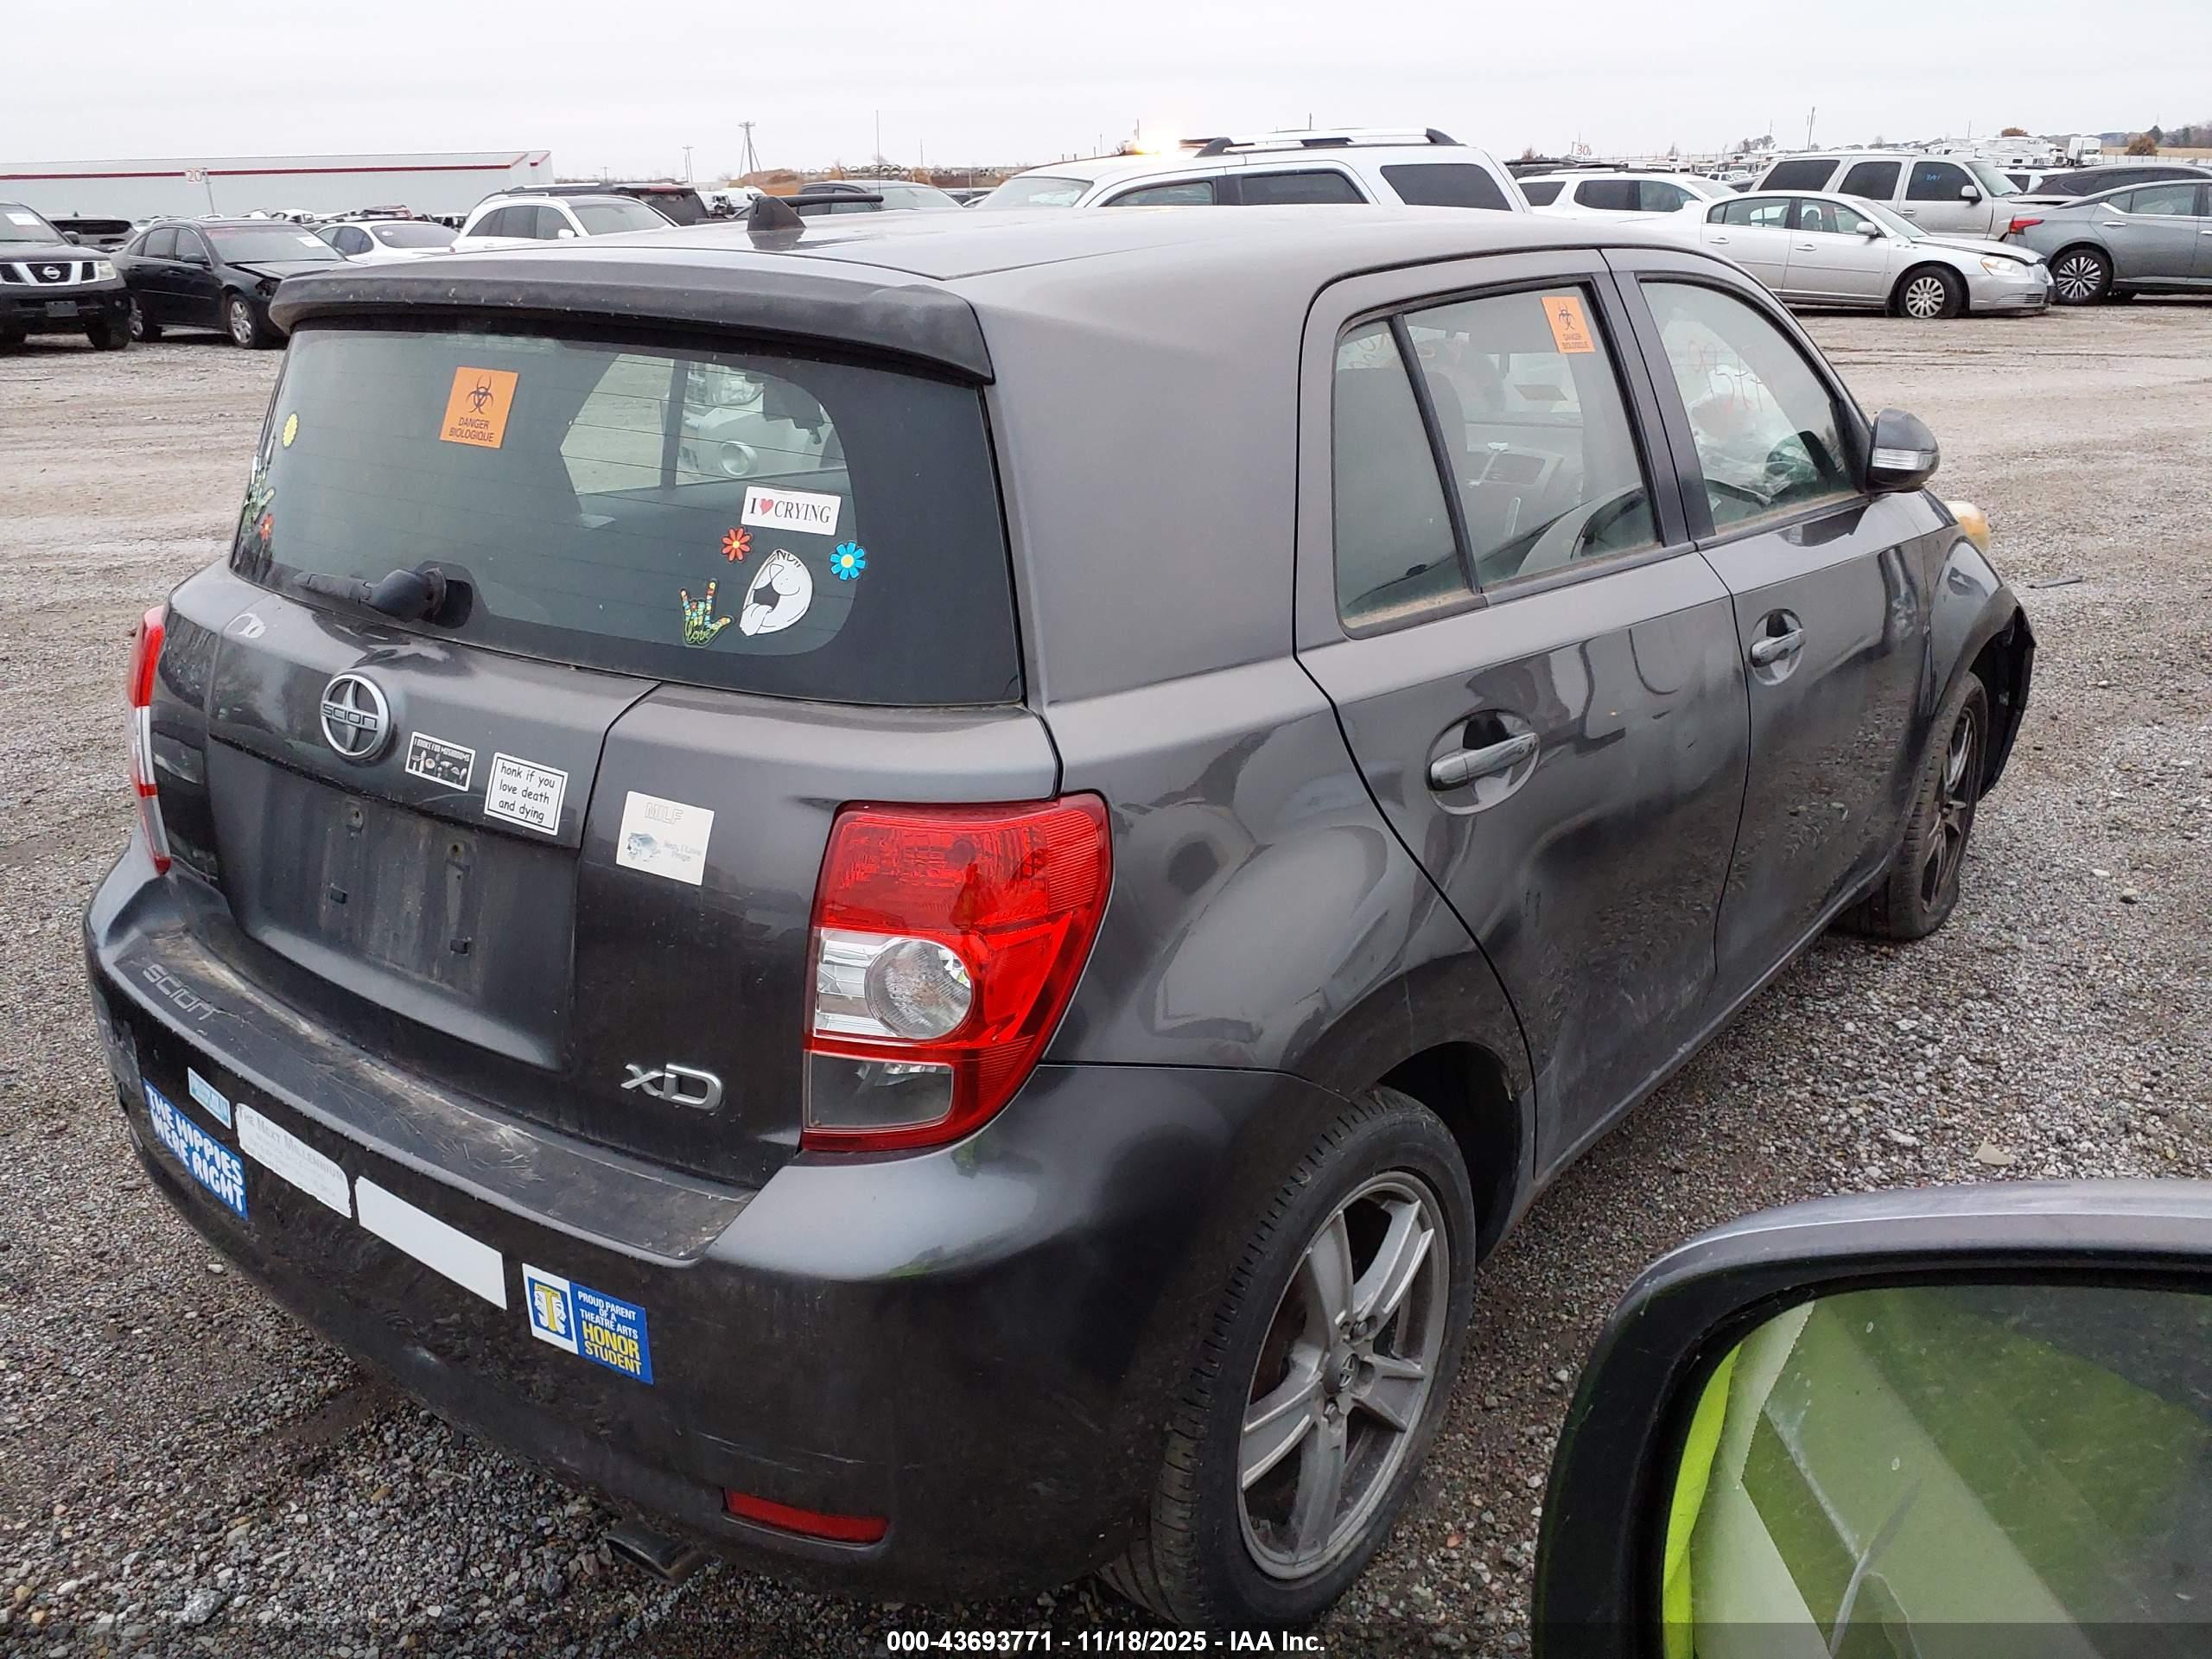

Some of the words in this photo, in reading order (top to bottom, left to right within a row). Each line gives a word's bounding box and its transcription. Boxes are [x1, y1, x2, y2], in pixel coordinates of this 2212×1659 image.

[448, 427, 495, 442] BIOLOGIQUE
[458, 416, 490, 429] DANGER
[749, 497, 758, 514] I
[774, 500, 831, 524] CRYING
[500, 761, 523, 779] honk
[526, 769, 536, 783] if
[538, 776, 556, 788] you
[499, 779, 518, 794] love
[521, 786, 550, 804] death
[499, 800, 516, 811] and
[518, 803, 544, 823] dying
[644, 802, 684, 824] MILF
[145, 1085, 175, 1129] THE
[175, 1114, 244, 1185] HIPPIES
[150, 1109, 189, 1166] WERE
[192, 1151, 244, 1211] RIGHT
[577, 1291, 605, 1308] PROUD
[606, 1302, 636, 1320] PARENT
[599, 1308, 609, 1318] OF
[611, 1313, 617, 1322] A
[579, 1308, 616, 1331] THEATRE
[616, 1323, 639, 1339] ARTS
[582, 1320, 640, 1361] HONOR
[584, 1340, 642, 1376] STUDENT
